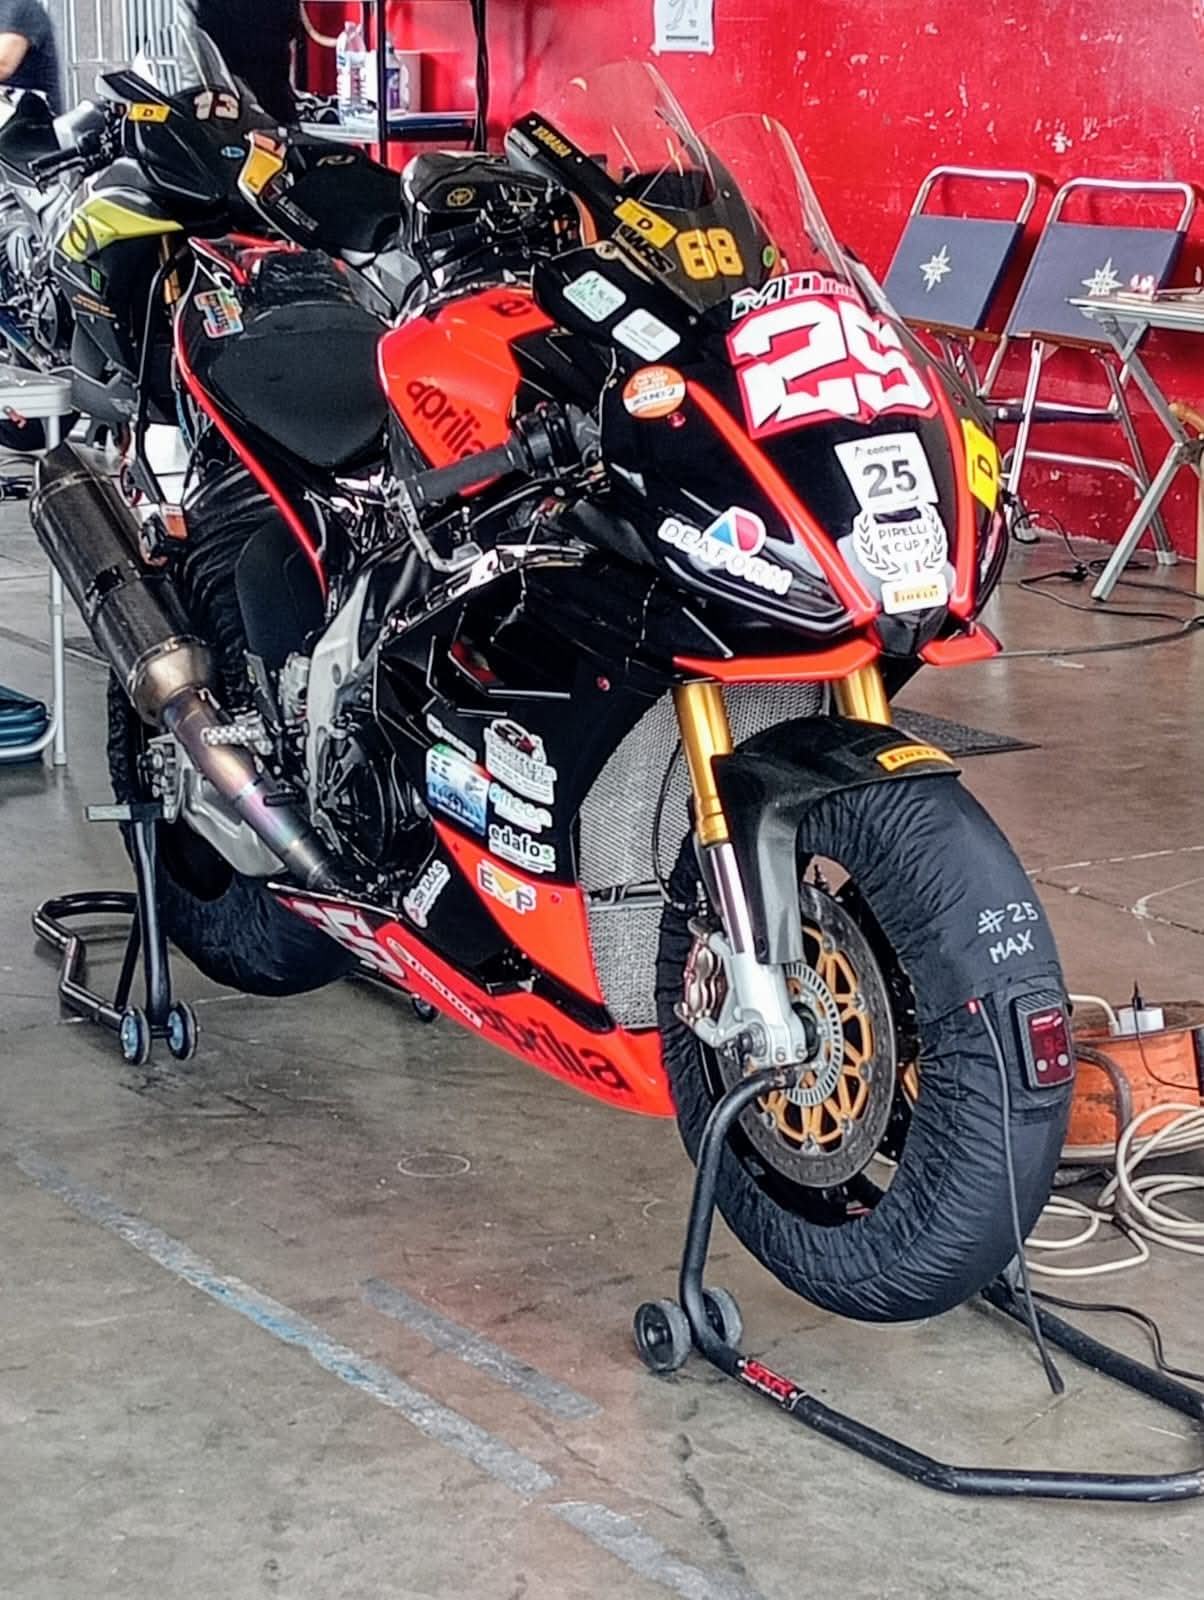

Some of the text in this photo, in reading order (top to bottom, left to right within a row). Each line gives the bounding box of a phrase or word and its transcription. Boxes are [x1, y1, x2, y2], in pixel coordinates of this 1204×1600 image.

[637, 218, 653, 231] D
[727, 299, 934, 438] 25
[862, 459, 917, 498] 25
[976, 453, 993, 481] D
[894, 540, 920, 553] CUP
[491, 826, 555, 860] edafos
[977, 901, 1038, 935] #25
[989, 929, 1035, 964] MAX
